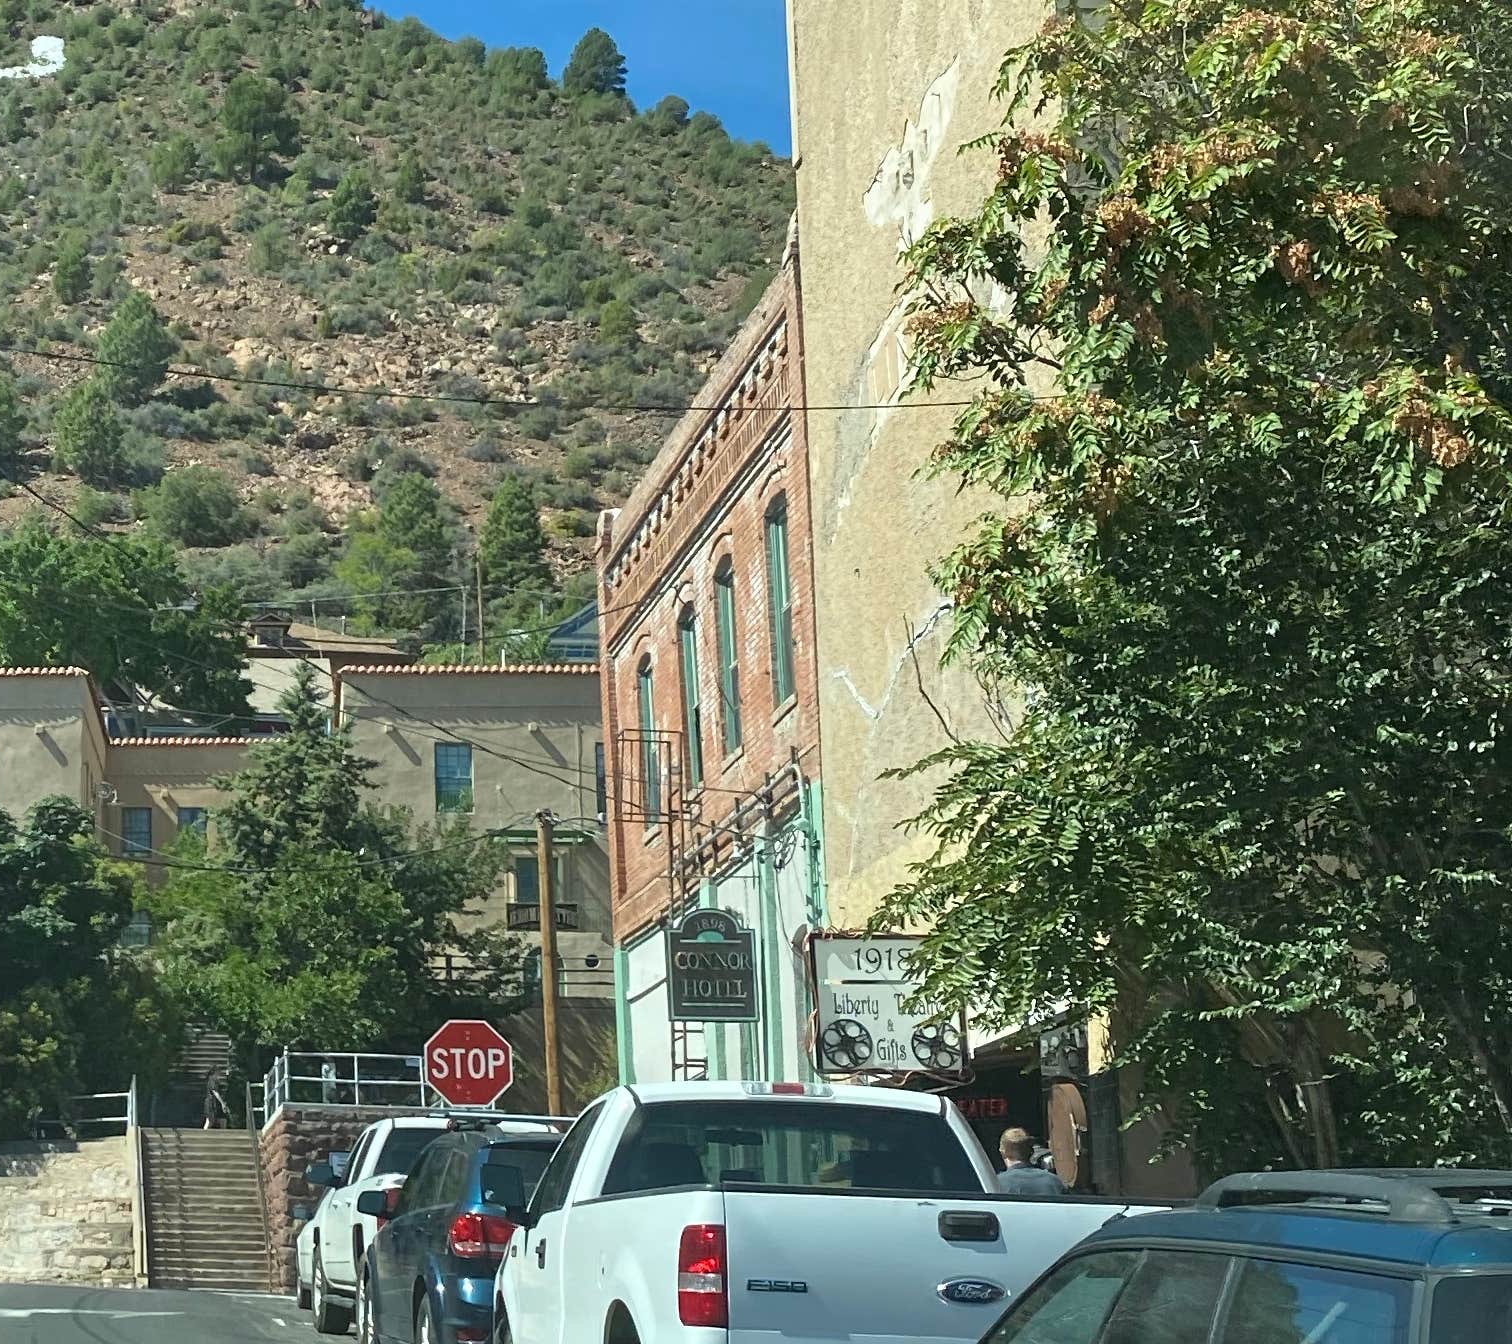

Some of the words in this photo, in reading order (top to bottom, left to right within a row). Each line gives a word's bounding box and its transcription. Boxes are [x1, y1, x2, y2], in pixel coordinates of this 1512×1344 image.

[695, 918, 726, 932] 1898
[674, 951, 752, 970] CONNOR
[681, 978, 748, 998] HOTEL
[833, 993, 879, 1020] Liberty
[887, 1018, 894, 1032] &
[876, 1038, 907, 1066] Gifts
[431, 1047, 506, 1080] STOP
[954, 1283, 992, 1299] Ford
